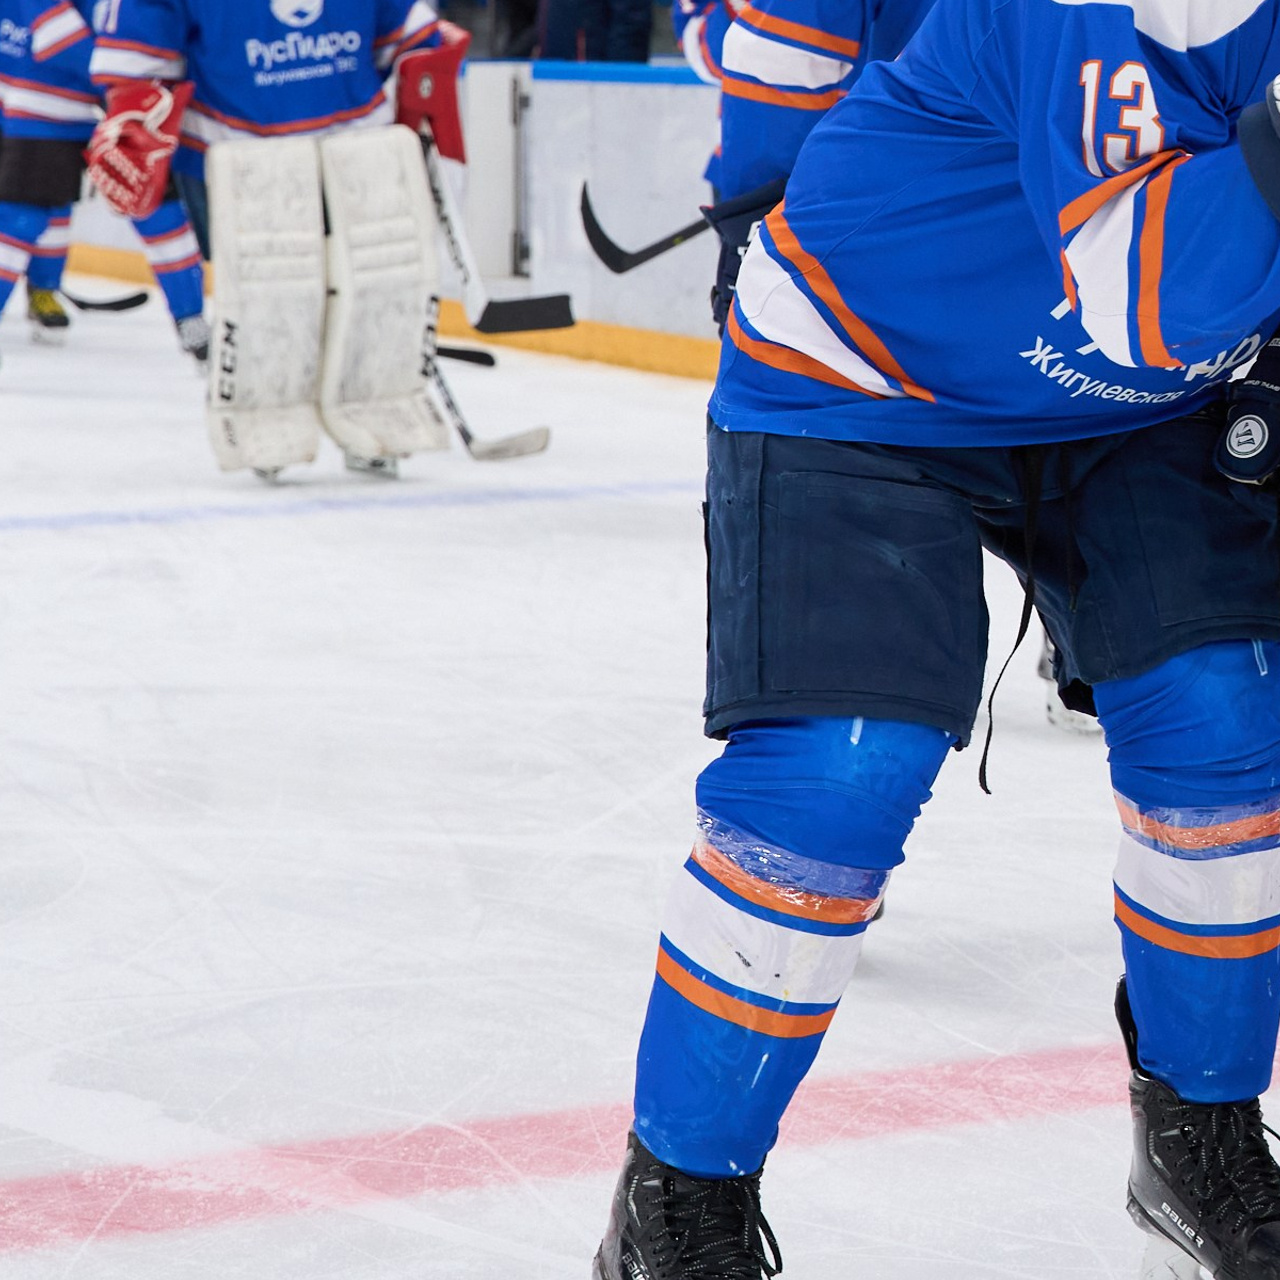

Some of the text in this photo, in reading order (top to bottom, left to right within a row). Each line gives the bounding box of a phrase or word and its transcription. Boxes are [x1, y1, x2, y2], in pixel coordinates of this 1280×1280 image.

[1079, 59, 1165, 178] 13
[218, 320, 238, 402] CCM
[1018, 334, 1186, 405] Жигулевская
[1161, 1201, 1205, 1249] BAUER
